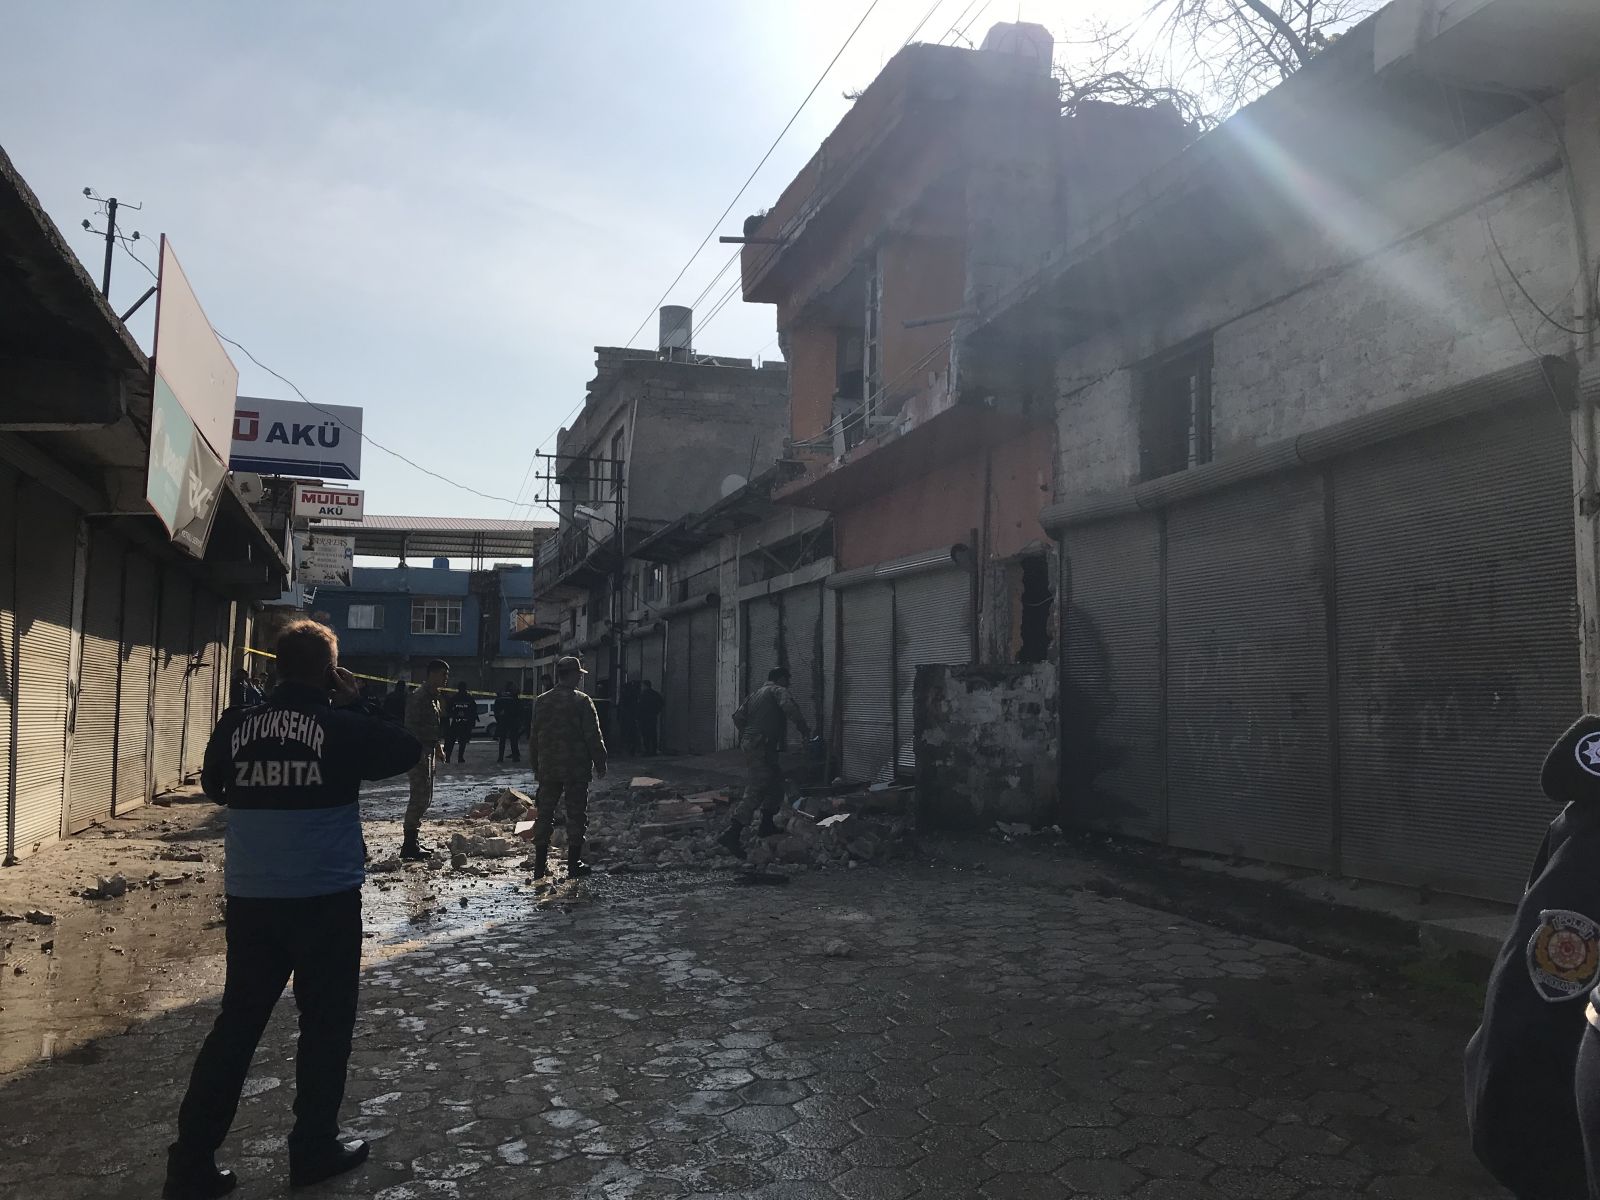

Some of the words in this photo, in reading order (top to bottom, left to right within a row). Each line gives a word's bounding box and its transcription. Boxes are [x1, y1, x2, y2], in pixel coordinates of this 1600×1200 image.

[266, 422, 340, 448] AKÜ
[301, 490, 359, 506] MUTLU
[319, 506, 343, 515] AKÜ
[231, 707, 325, 760] BÜYÜKŞEHİR
[235, 761, 323, 787] ZABITA
